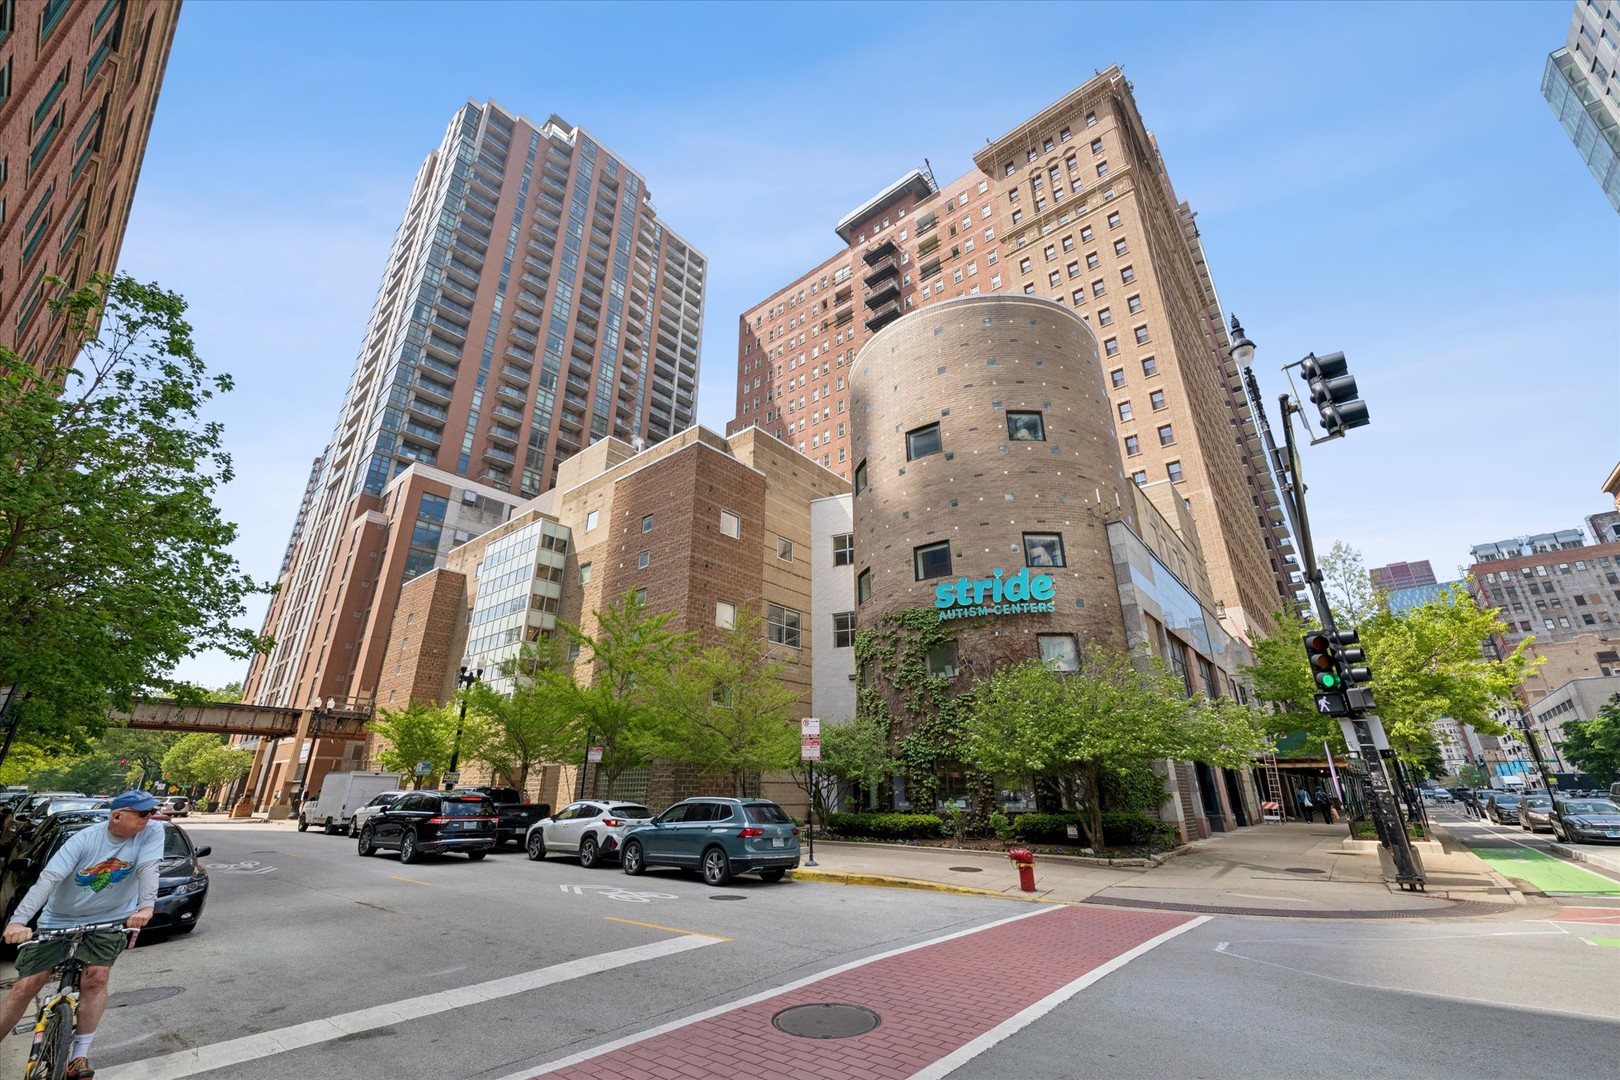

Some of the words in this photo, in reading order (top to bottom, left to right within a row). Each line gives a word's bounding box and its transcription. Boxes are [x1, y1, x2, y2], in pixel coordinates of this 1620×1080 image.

[934, 567, 1056, 608] stride
[938, 606, 988, 620] AUTISM
[994, 602, 1055, 614] CENTERS
